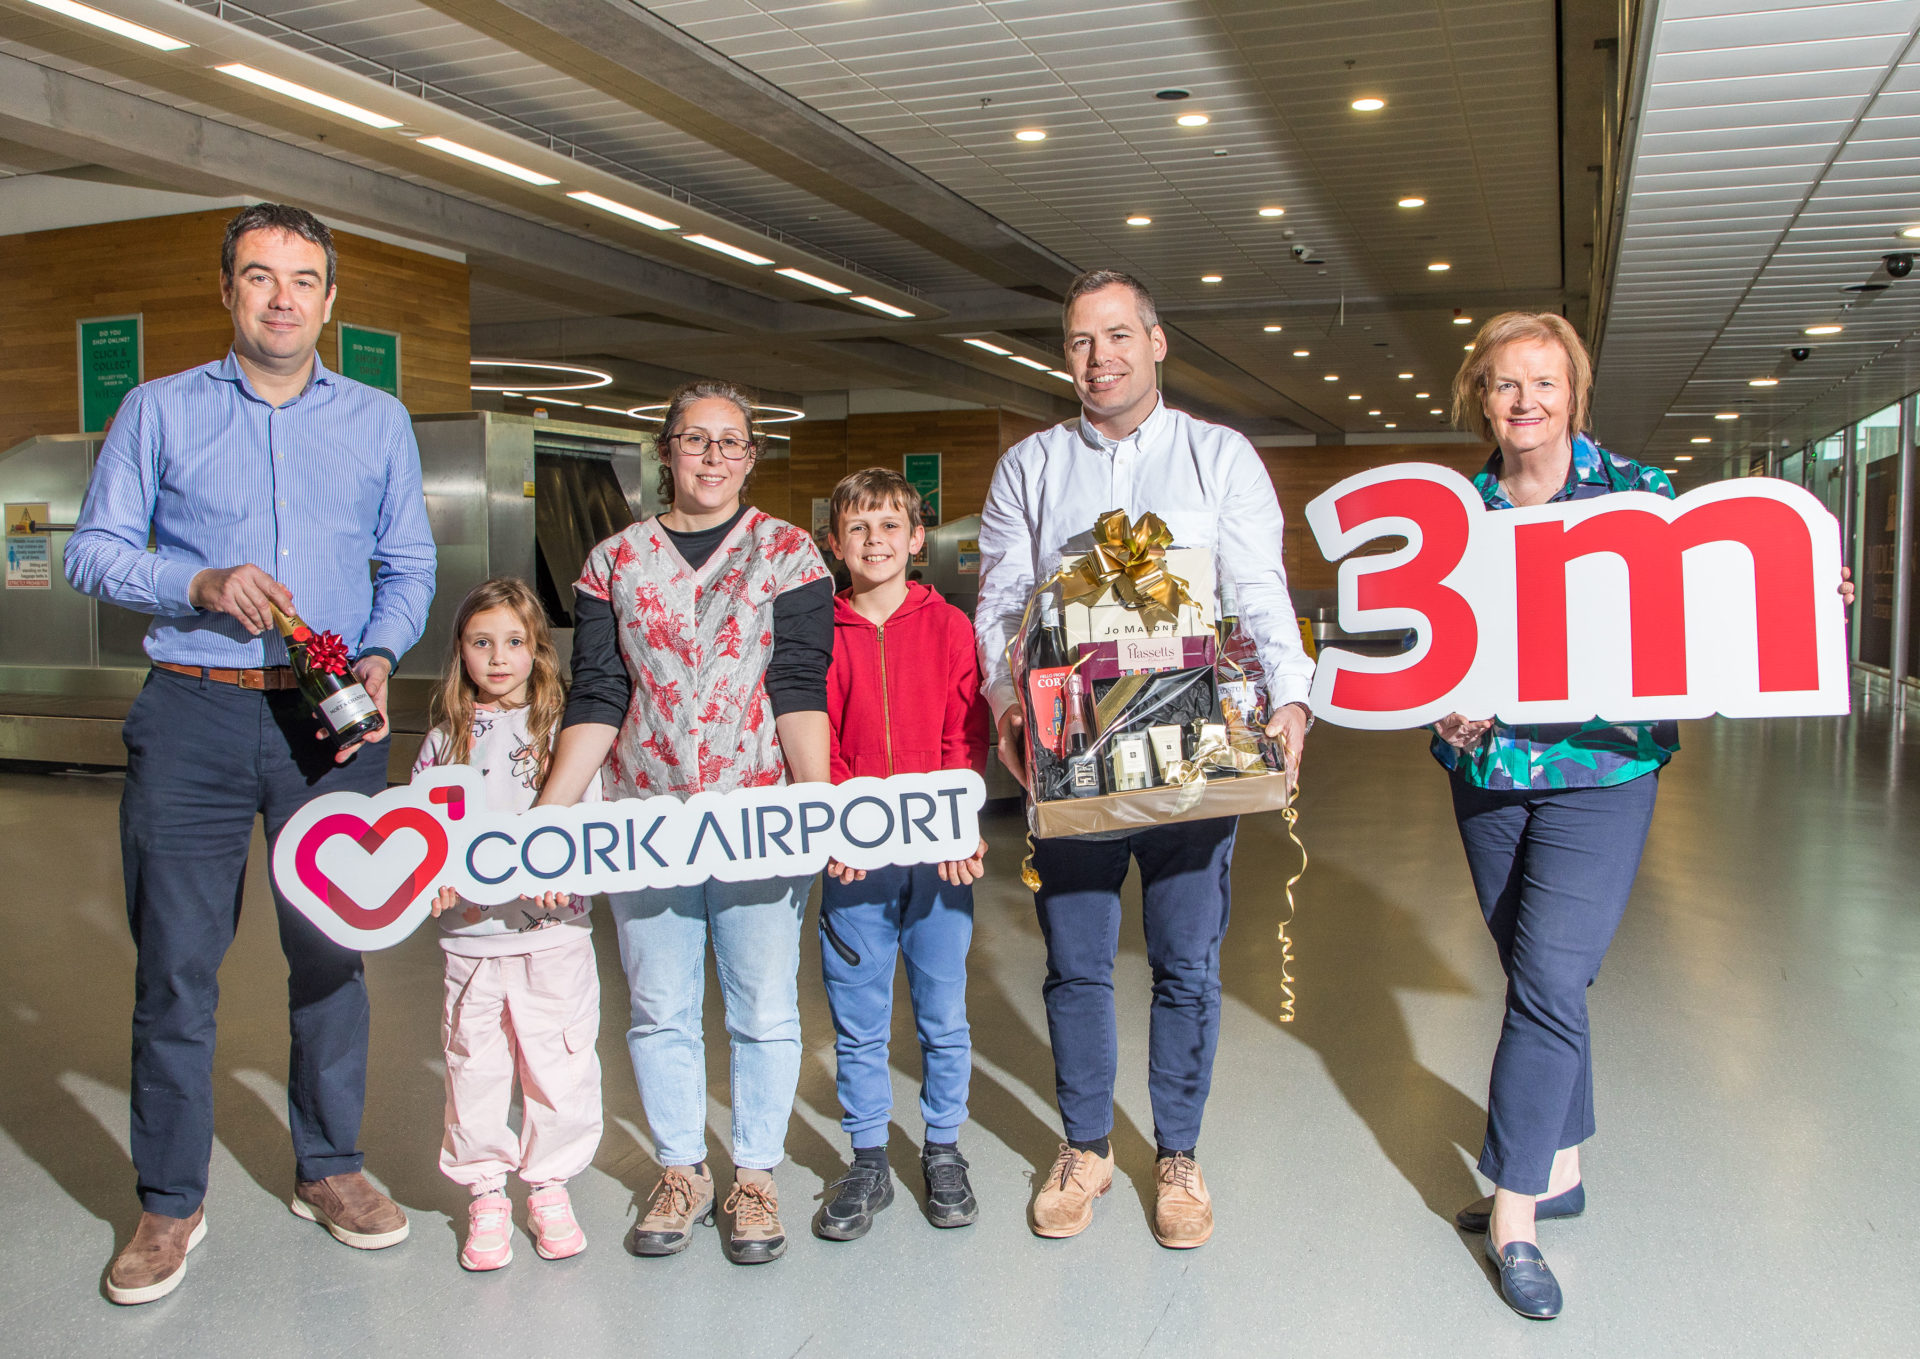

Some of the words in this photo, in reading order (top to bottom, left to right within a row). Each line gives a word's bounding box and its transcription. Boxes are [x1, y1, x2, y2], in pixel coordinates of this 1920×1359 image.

[92, 338, 107, 346] SHOP
[92, 349, 118, 360] CLICK
[92, 360, 131, 371] COLLECT
[1330, 478, 1819, 712] 3m
[1104, 626, 1119, 635] Jo
[1124, 624, 1178, 634] MALONE
[466, 815, 669, 885] CORK
[686, 787, 968, 865] AIRPORT
